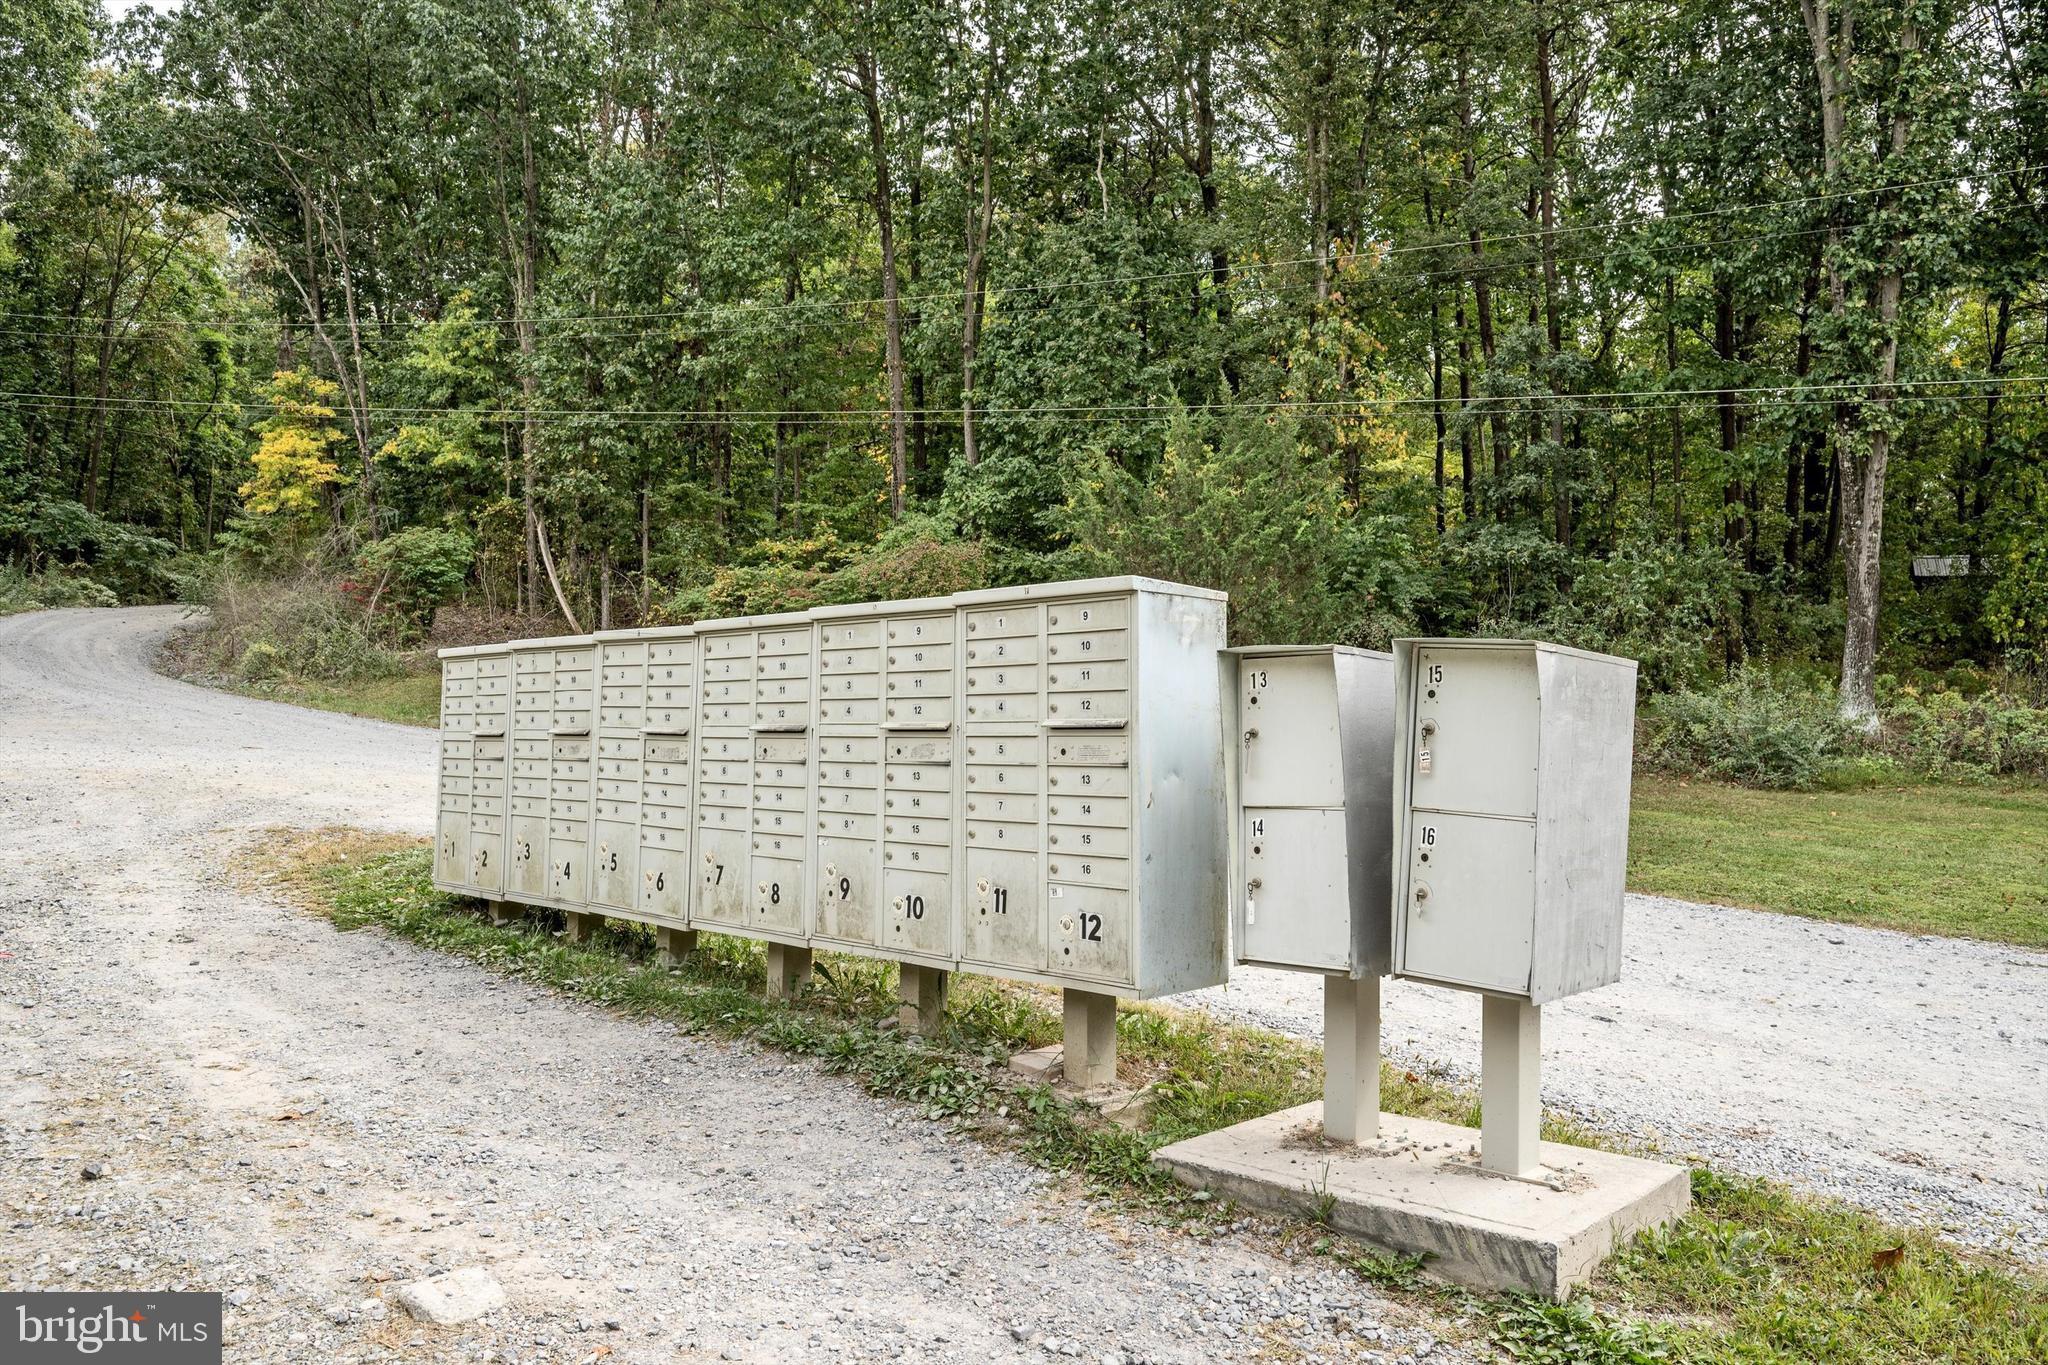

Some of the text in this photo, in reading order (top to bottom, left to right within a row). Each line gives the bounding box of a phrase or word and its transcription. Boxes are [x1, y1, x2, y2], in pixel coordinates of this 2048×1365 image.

[1083, 611, 1088, 621] 9
[999, 618, 1003, 628] 1
[848, 630, 852, 639] 1
[916, 626, 921, 635] 9
[726, 642, 730, 650] 1
[781, 638, 786, 646] 9
[1081, 641, 1090, 651] 10
[998, 646, 1004, 656] 2
[847, 656, 852, 665] 2
[915, 653, 923, 662] 10
[725, 664, 730, 673] 2
[779, 662, 787, 670] 10
[998, 674, 1004, 684] 3
[1081, 670, 1090, 680] 11
[1429, 665, 1443, 684] 15
[846, 680, 852, 690] 3
[914, 679, 923, 688] 11
[1251, 672, 1267, 689] 13
[724, 687, 729, 696] 3
[779, 686, 786, 694] 11
[998, 702, 1004, 712] 4
[1081, 700, 1090, 710] 12
[724, 710, 728, 718] 4
[778, 710, 785, 718] 12
[846, 706, 851, 715] 4
[914, 706, 922, 715] 12
[723, 744, 727, 752] 5
[846, 744, 851, 753] 5
[998, 745, 1004, 755] 5
[1421, 752, 1429, 762] 15
[722, 766, 726, 775] 6
[776, 769, 783, 778] 13
[845, 769, 850, 778] 6
[912, 772, 921, 780] 13
[998, 772, 1004, 782] 6
[1081, 775, 1090, 784] 13
[721, 789, 726, 798] 7
[775, 793, 783, 801] 14
[844, 794, 849, 803] 7
[912, 798, 920, 807] 14
[998, 801, 1004, 811] 7
[1082, 805, 1091, 815] 14
[720, 812, 725, 821] 8
[774, 817, 782, 825] 15
[844, 819, 849, 828] 8
[1252, 819, 1264, 837] 14
[912, 825, 920, 834] 15
[998, 829, 1004, 839] 8
[1082, 834, 1091, 844] 15
[1422, 827, 1435, 845] 16
[452, 841, 455, 858] 1
[774, 841, 781, 849] 16
[524, 843, 530, 860] 3
[911, 852, 920, 861] 16
[482, 850, 488, 867] 2
[610, 853, 617, 871] 5
[564, 862, 571, 880] 4
[1082, 864, 1091, 874] 16
[716, 865, 724, 885] 7
[656, 872, 664, 891] 6
[771, 883, 780, 904] 8
[840, 877, 850, 900] 9
[993, 888, 1007, 914] 11
[906, 895, 924, 920] 10
[1080, 913, 1102, 942] 12
